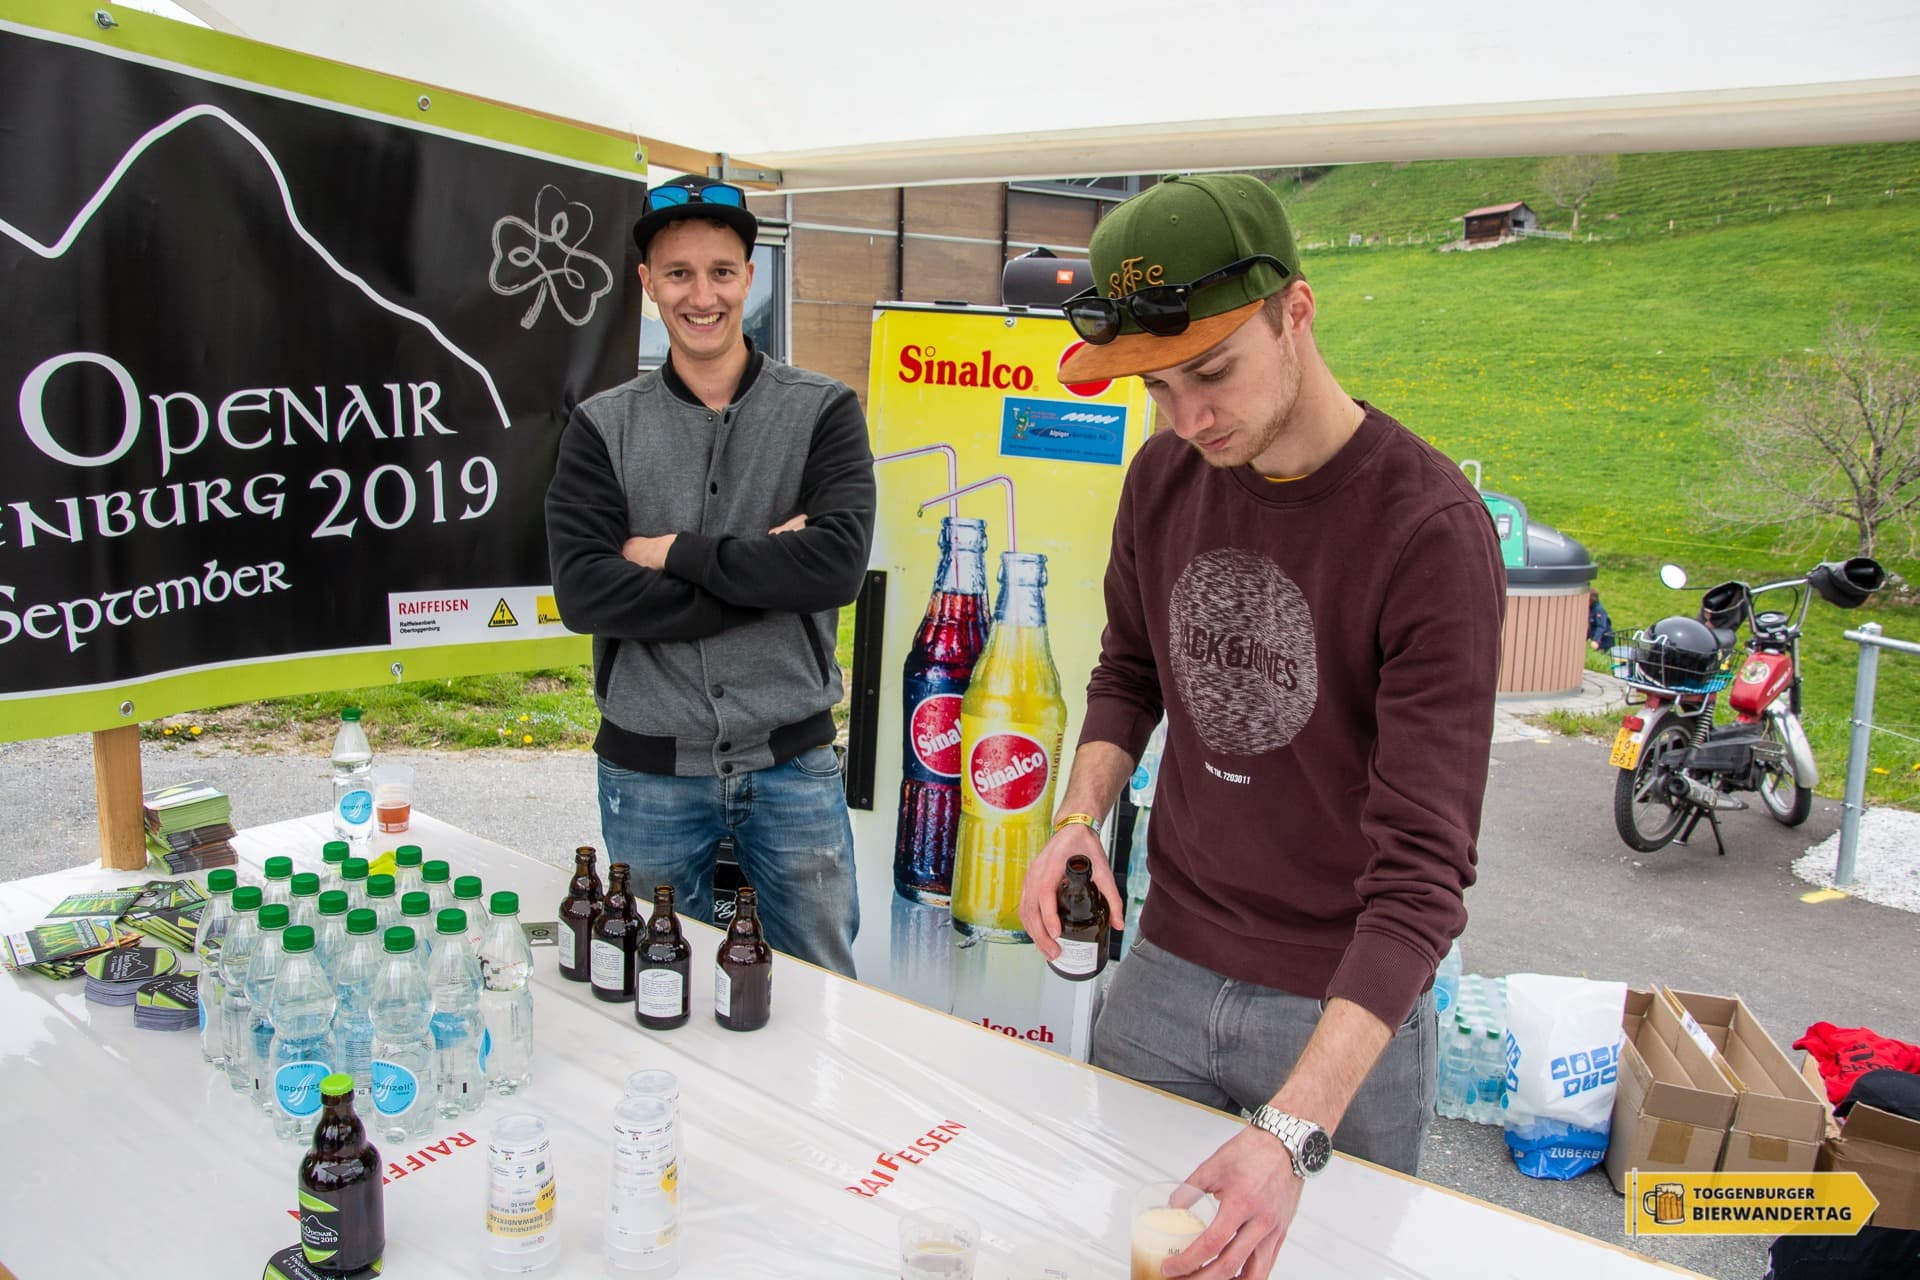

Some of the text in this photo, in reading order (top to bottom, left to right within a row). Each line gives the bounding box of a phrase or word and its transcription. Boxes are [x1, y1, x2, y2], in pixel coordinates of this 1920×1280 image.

[898, 344, 1034, 391] Sinalco
[0, 455, 498, 548] NBURG 2019
[398, 598, 469, 615] RAIFFEISEN
[974, 752, 1044, 793] Sinalco
[980, 1017, 1055, 1044] lco.ch
